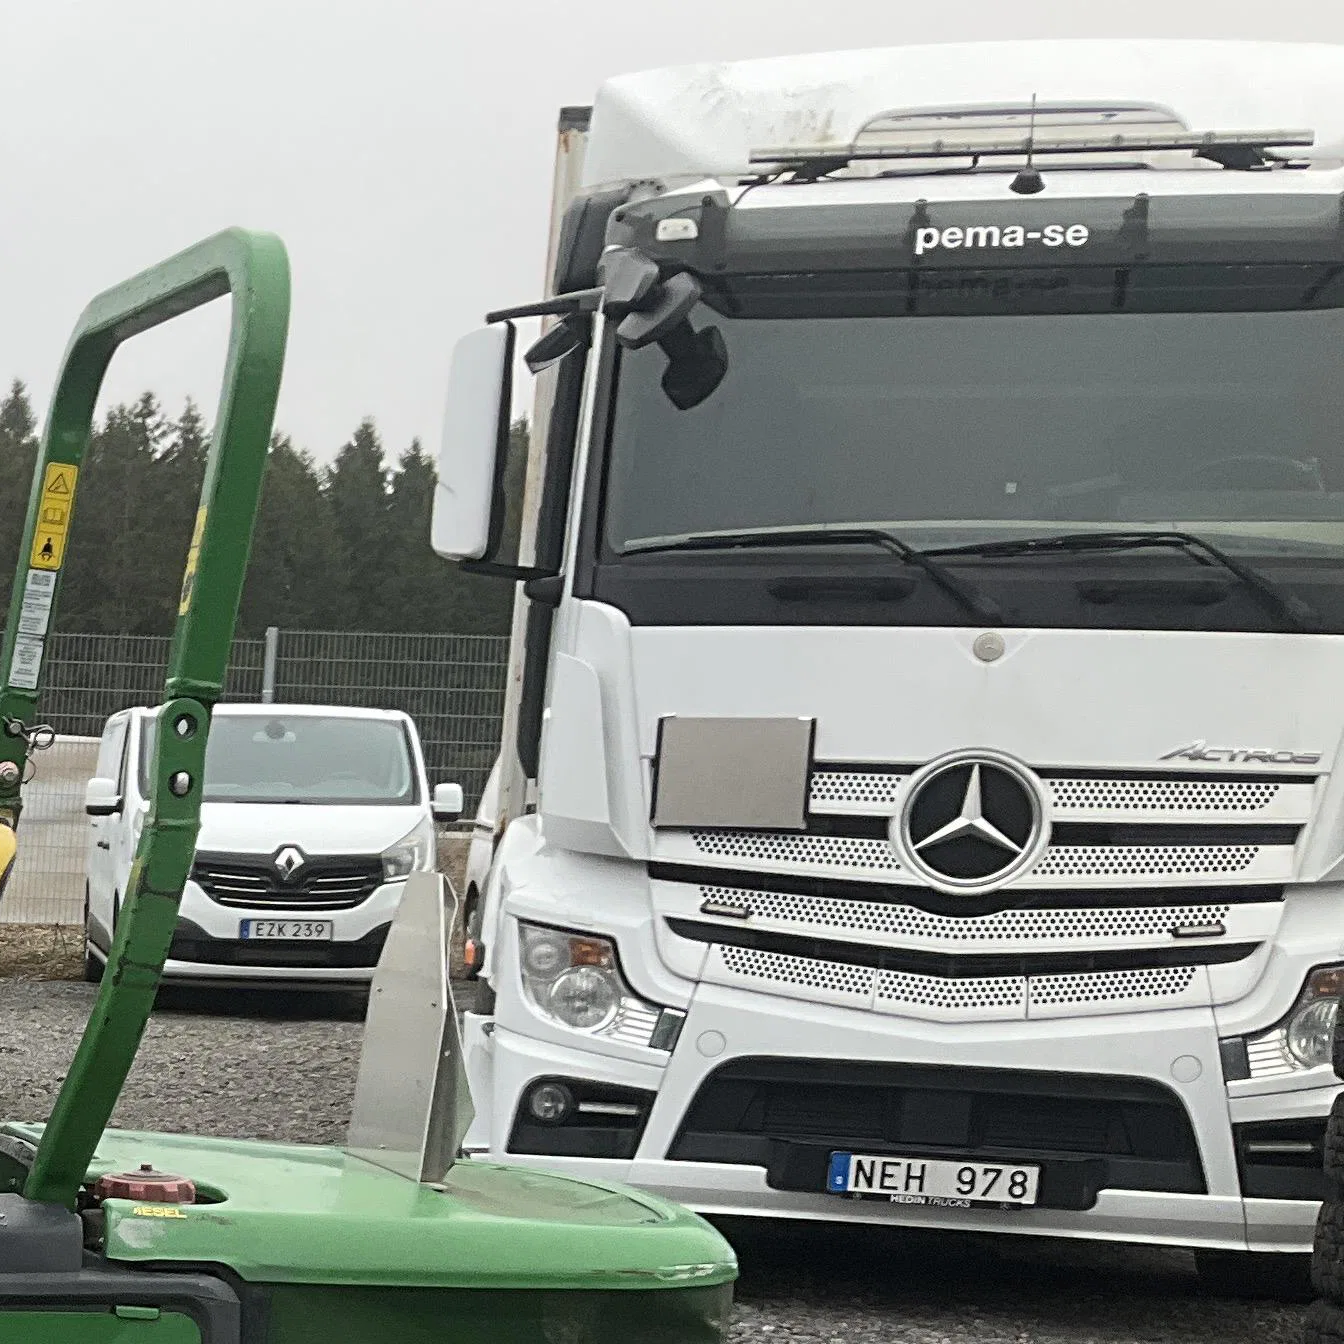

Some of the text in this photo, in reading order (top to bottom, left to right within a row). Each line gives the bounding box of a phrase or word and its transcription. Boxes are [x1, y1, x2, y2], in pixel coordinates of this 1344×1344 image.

[915, 223, 1090, 256] pema-se
[255, 922, 325, 938] EZK 239
[853, 1158, 1028, 1200] NEH 978
